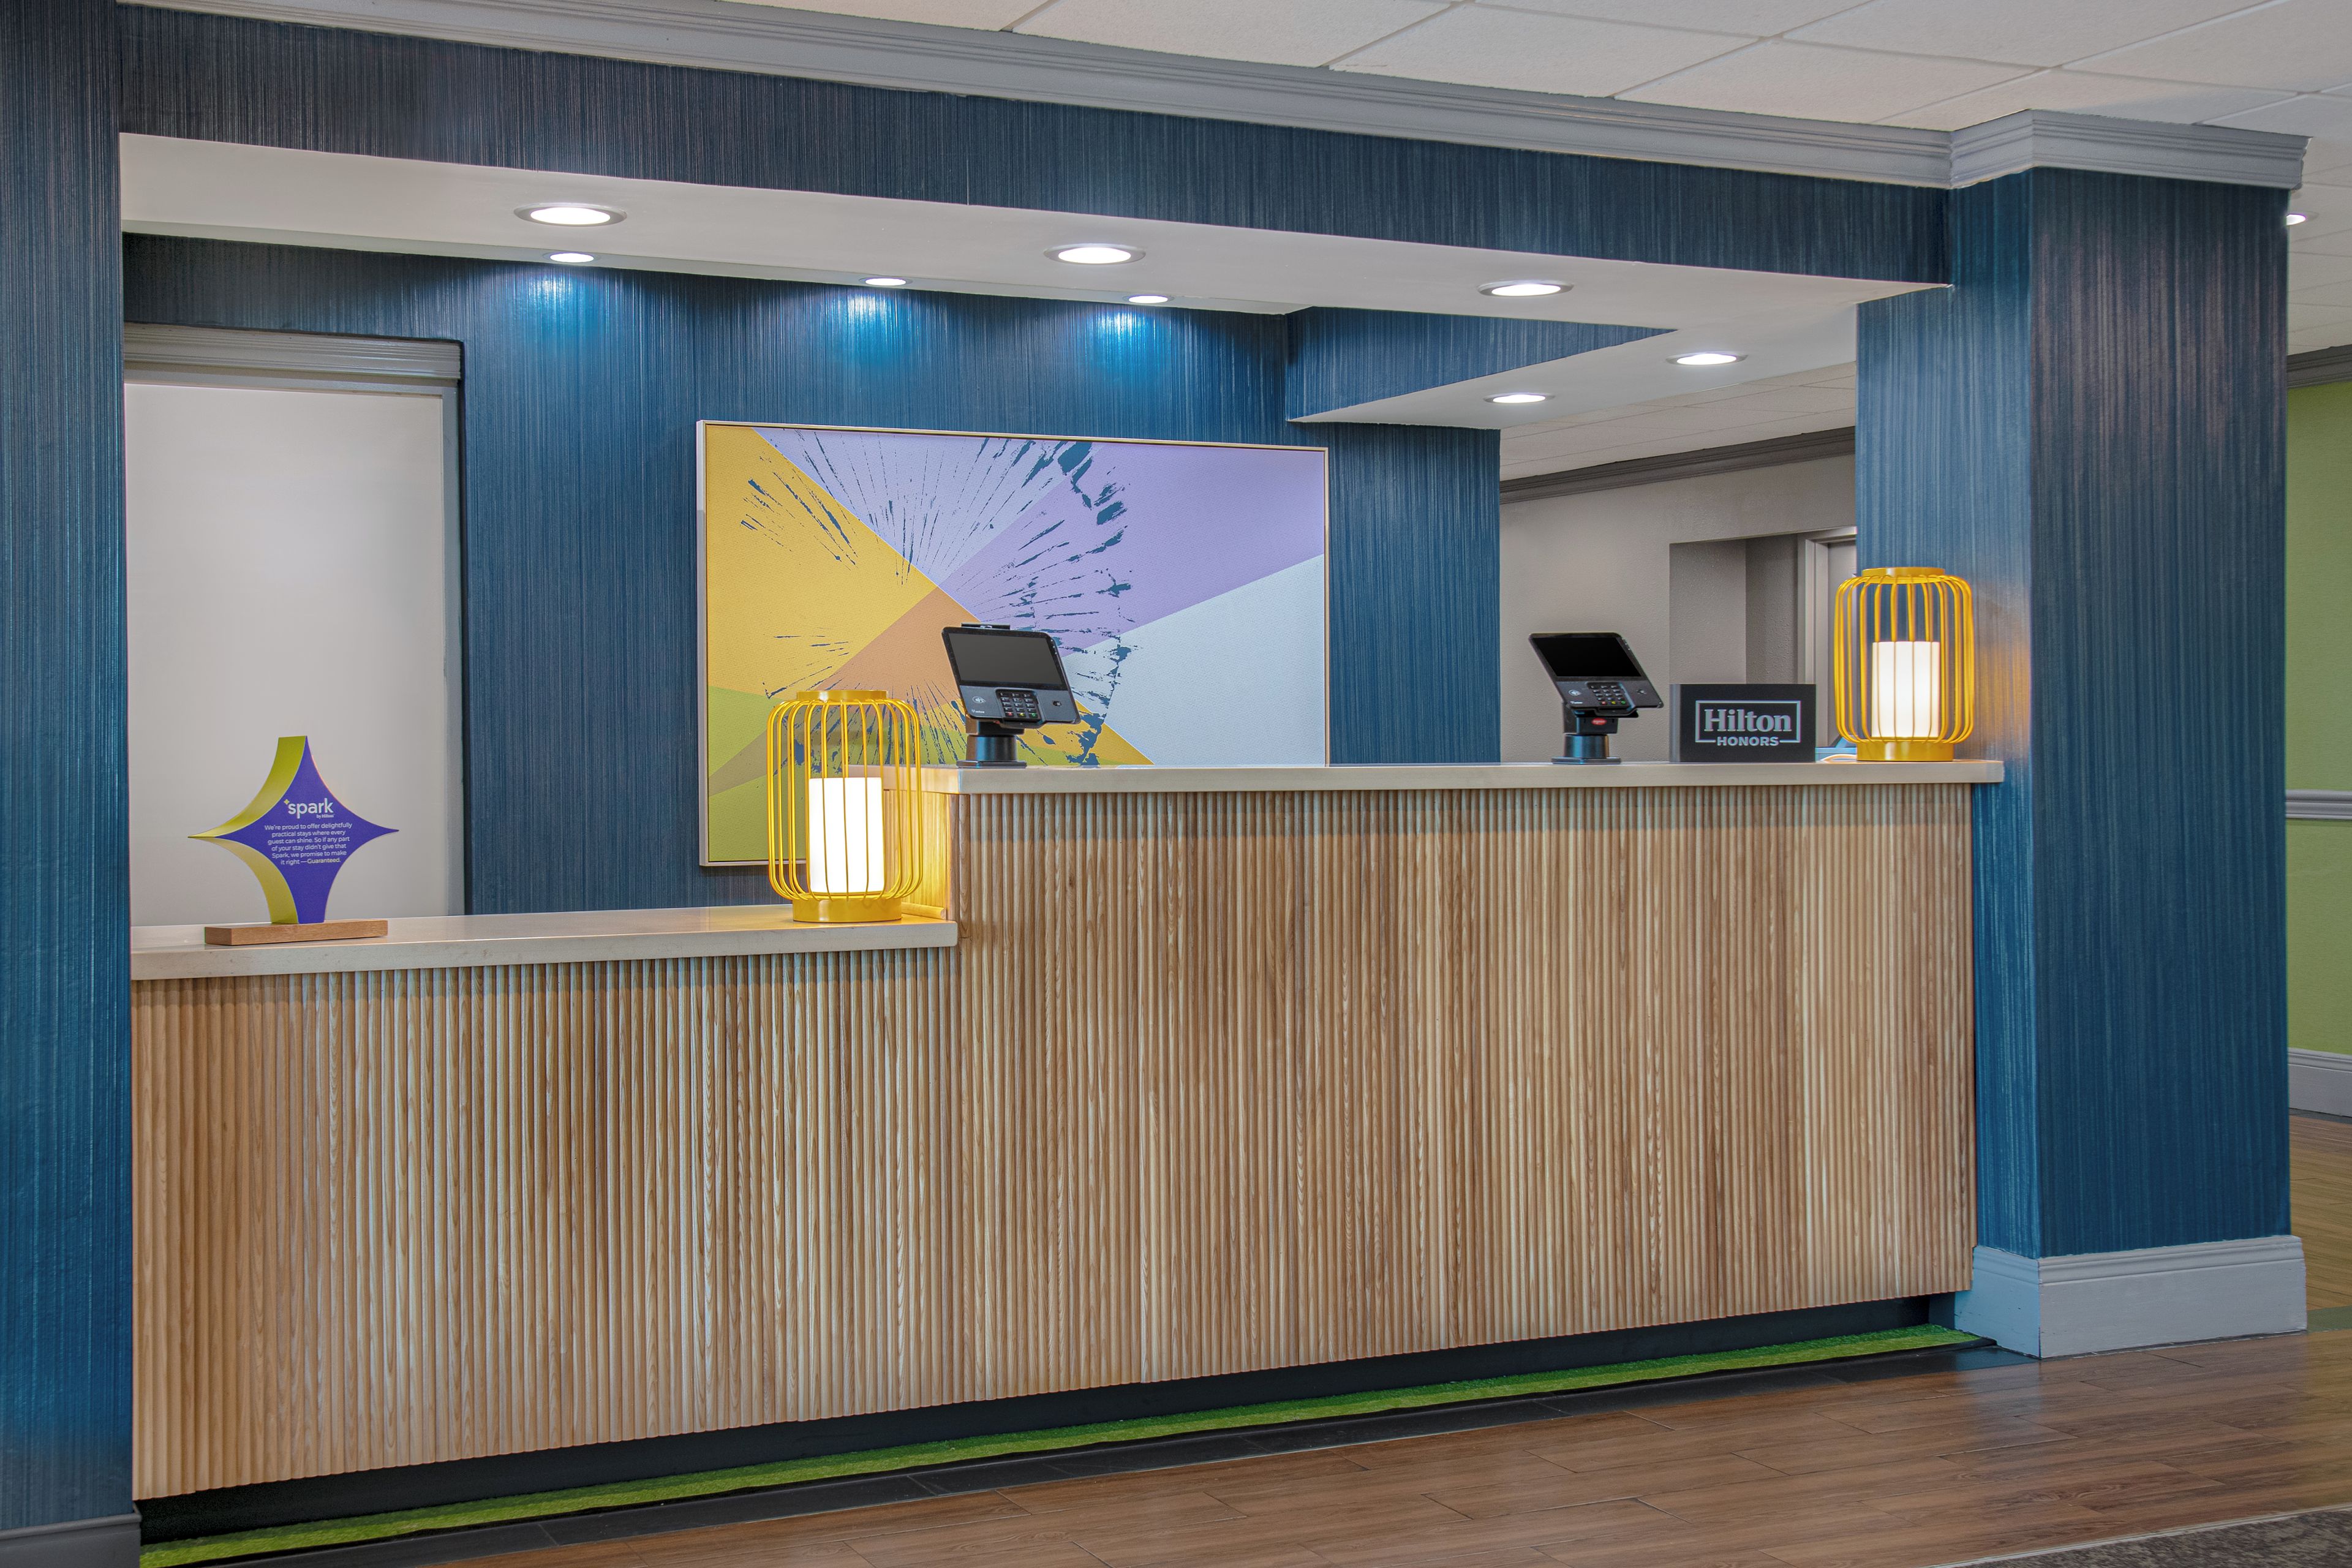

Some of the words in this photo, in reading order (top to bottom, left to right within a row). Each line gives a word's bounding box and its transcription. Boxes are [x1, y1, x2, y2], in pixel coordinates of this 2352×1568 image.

[1703, 709, 1792, 733] Hilton
[1717, 736, 1779, 747] HONORS
[288, 797, 333, 818] spark
